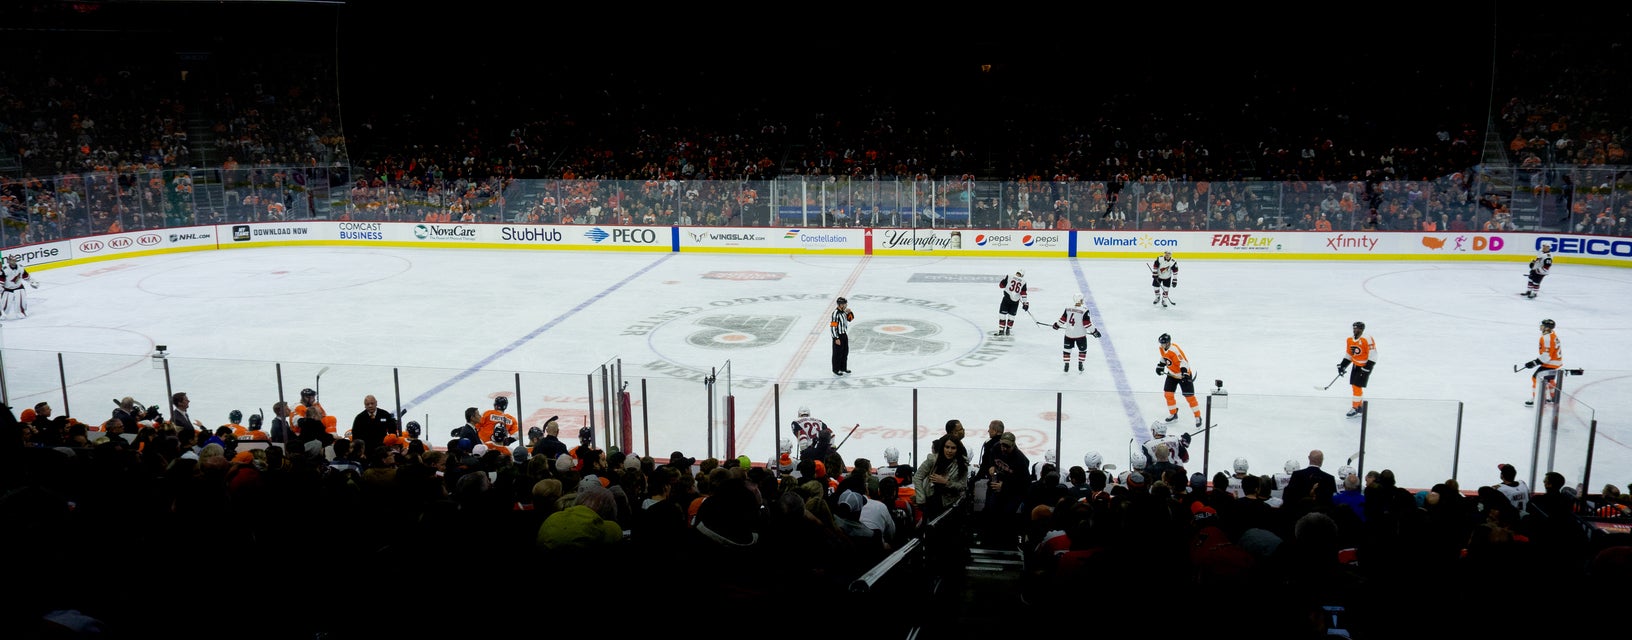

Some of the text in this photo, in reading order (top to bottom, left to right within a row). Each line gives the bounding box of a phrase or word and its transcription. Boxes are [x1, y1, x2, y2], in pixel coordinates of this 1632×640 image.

[253, 227, 308, 236] DOWNLOAD NOW
[339, 222, 382, 231] COMCAST
[430, 225, 476, 237] NovaCare
[140, 235, 158, 244] KIA
[340, 231, 383, 240] BUSINESS
[501, 226, 562, 242] StubHub
[612, 228, 656, 244] PECO
[800, 234, 847, 243] Constellation
[882, 229, 951, 248] Yuengling
[988, 234, 1012, 244] pepsi
[112, 237, 129, 247] KIA
[1035, 235, 1059, 245] pepsi
[1093, 236, 1178, 247] Walmart com
[1326, 233, 1379, 251] xfinity
[83, 242, 100, 251] KIA
[1535, 236, 1632, 257] GEICO
[1, 246, 59, 264] nterprise
[1009, 280, 1022, 294] 36
[1069, 312, 1076, 326] 4
